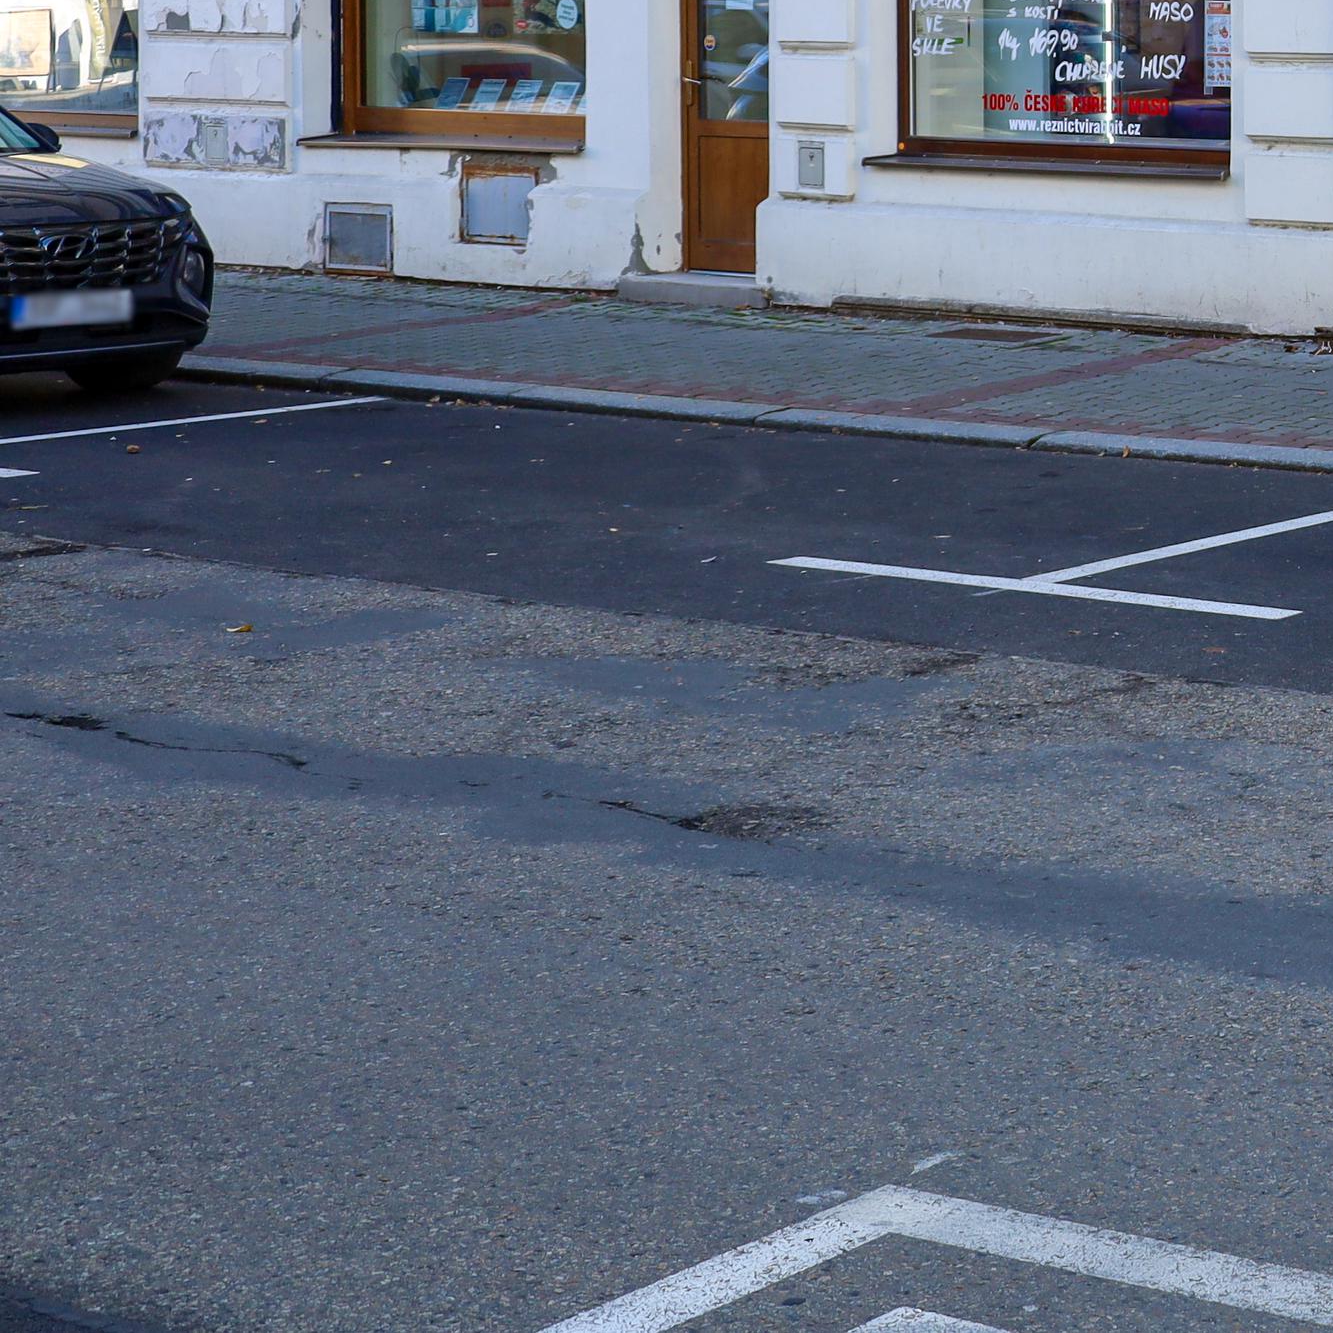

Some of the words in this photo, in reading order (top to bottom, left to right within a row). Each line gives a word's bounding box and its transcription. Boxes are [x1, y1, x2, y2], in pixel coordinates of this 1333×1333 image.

[1149, 1, 1194, 22] MASO
[924, 14, 943, 33] VE
[912, 38, 956, 57] SKLE
[1140, 54, 1186, 79] HUSY
[982, 94, 1018, 111] 100%
[1024, 90, 1067, 112] ČESKÉ
[1128, 97, 1170, 116] MASO
